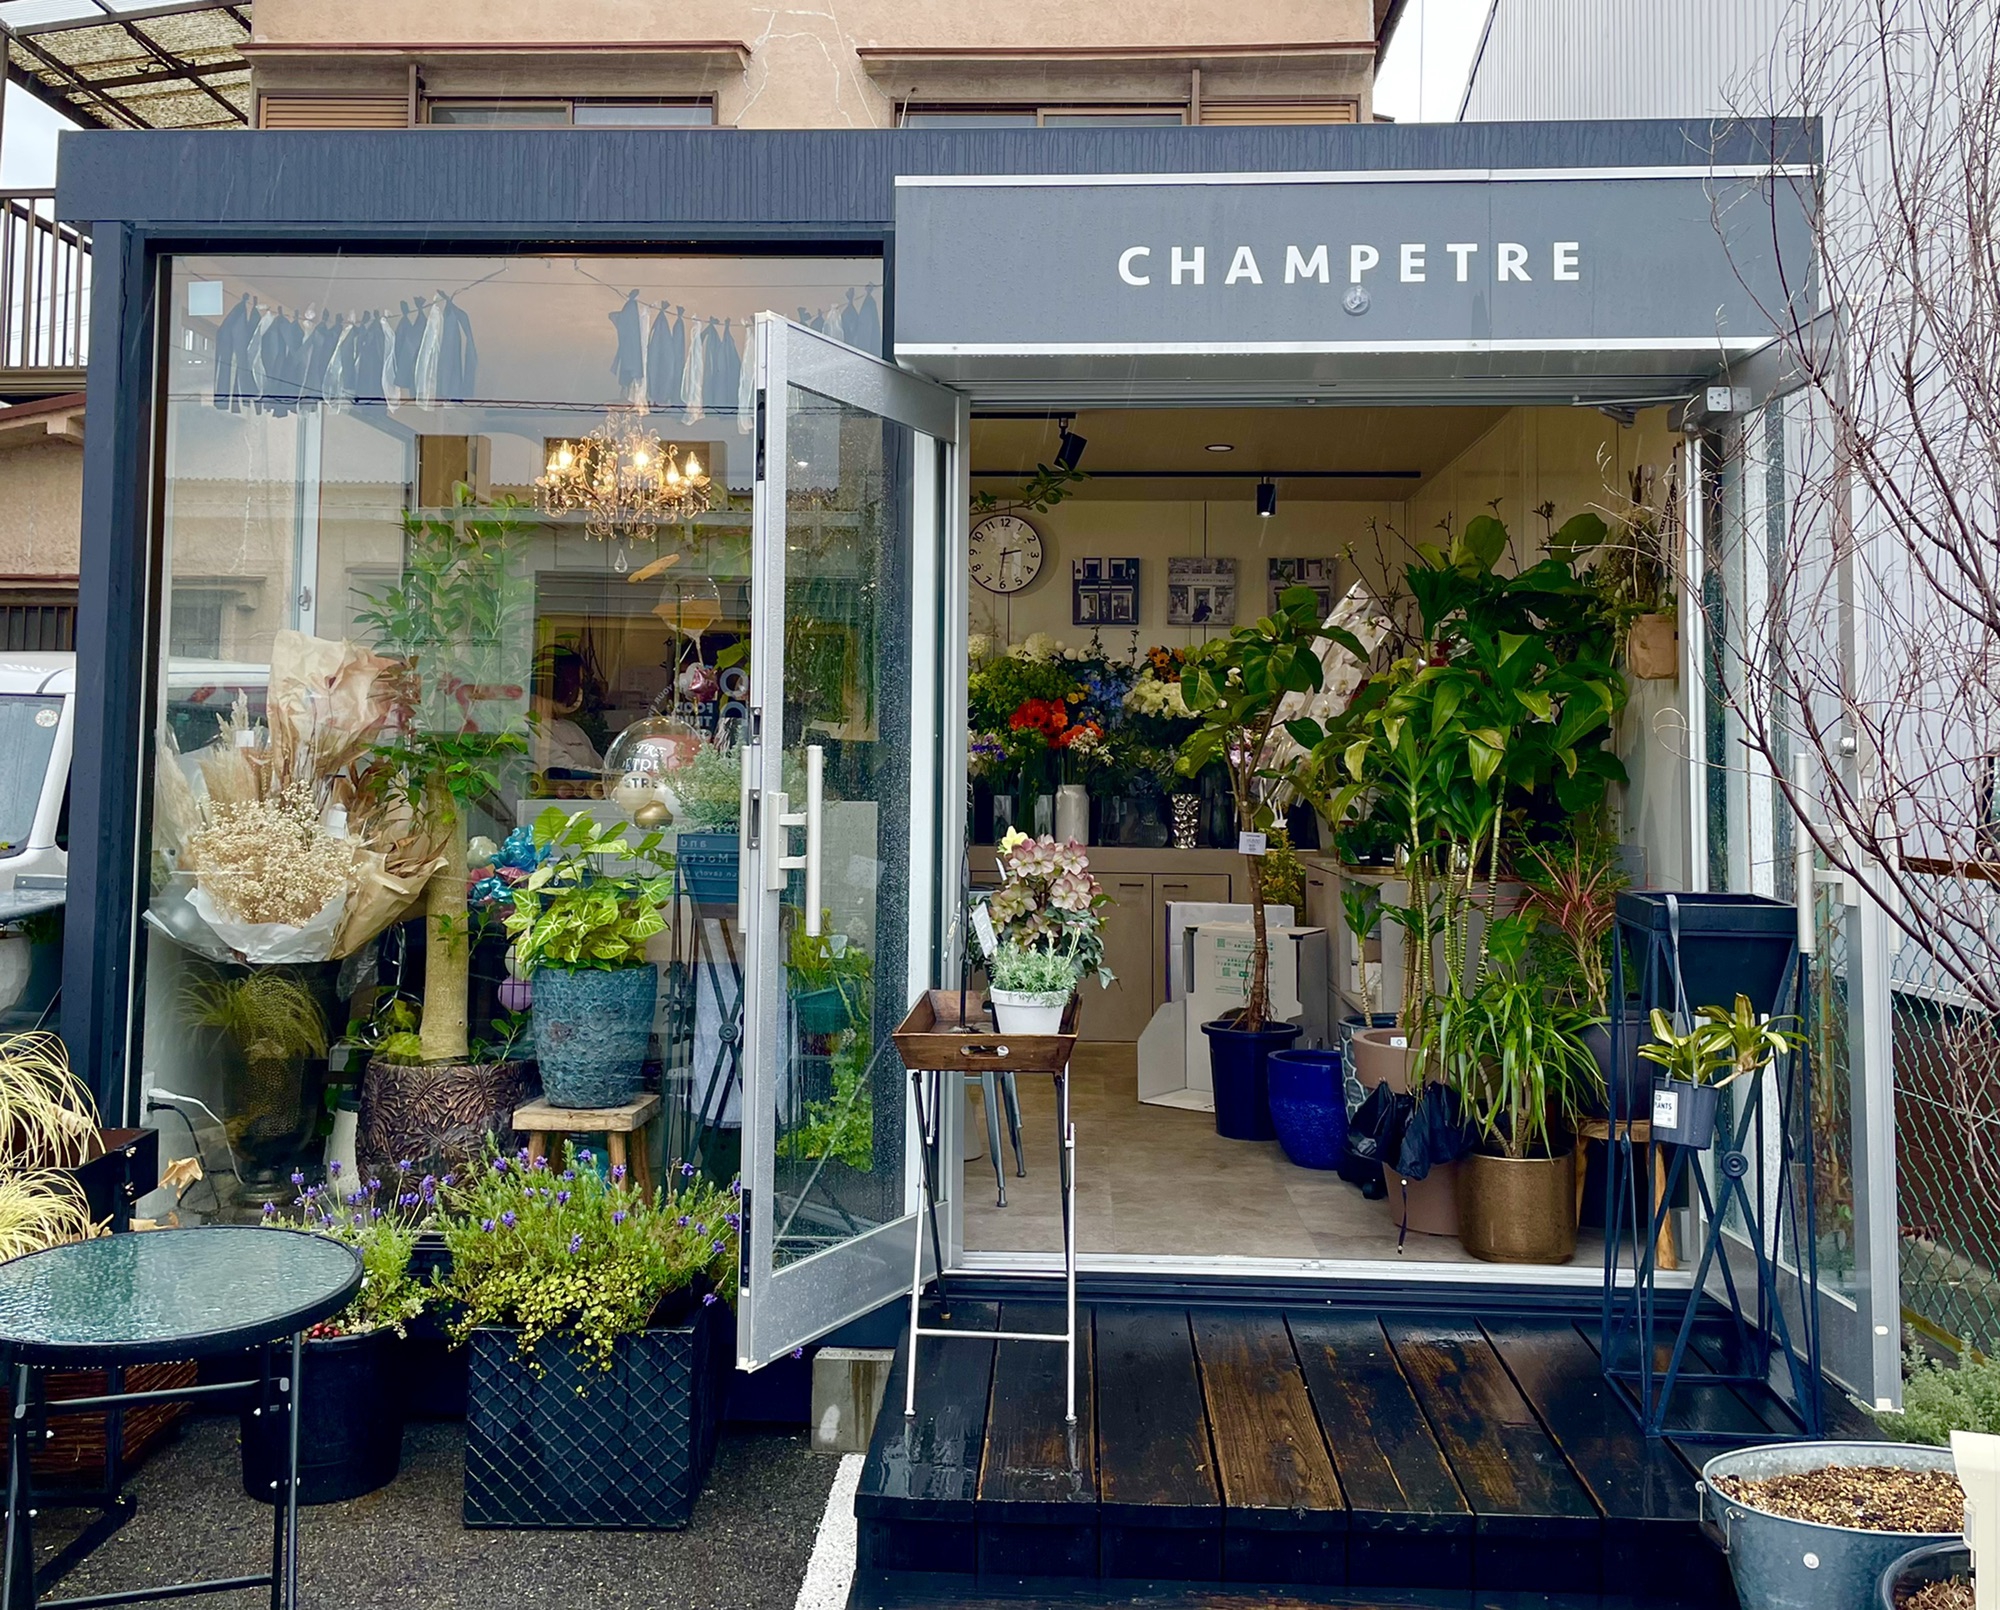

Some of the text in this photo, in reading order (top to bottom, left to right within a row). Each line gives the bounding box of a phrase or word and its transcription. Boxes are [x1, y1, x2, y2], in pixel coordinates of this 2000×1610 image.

[1117, 241, 1581, 286] CHAMPETRE
[985, 521, 995, 531] 11
[1000, 518, 1010, 528] 12
[972, 532, 984, 542] 10
[1027, 535, 1036, 544] 2
[972, 564, 982, 572] 8
[1026, 566, 1034, 574] 4
[983, 576, 992, 584] 7
[1000, 580, 1006, 589] 6
[1014, 577, 1022, 586] 5
